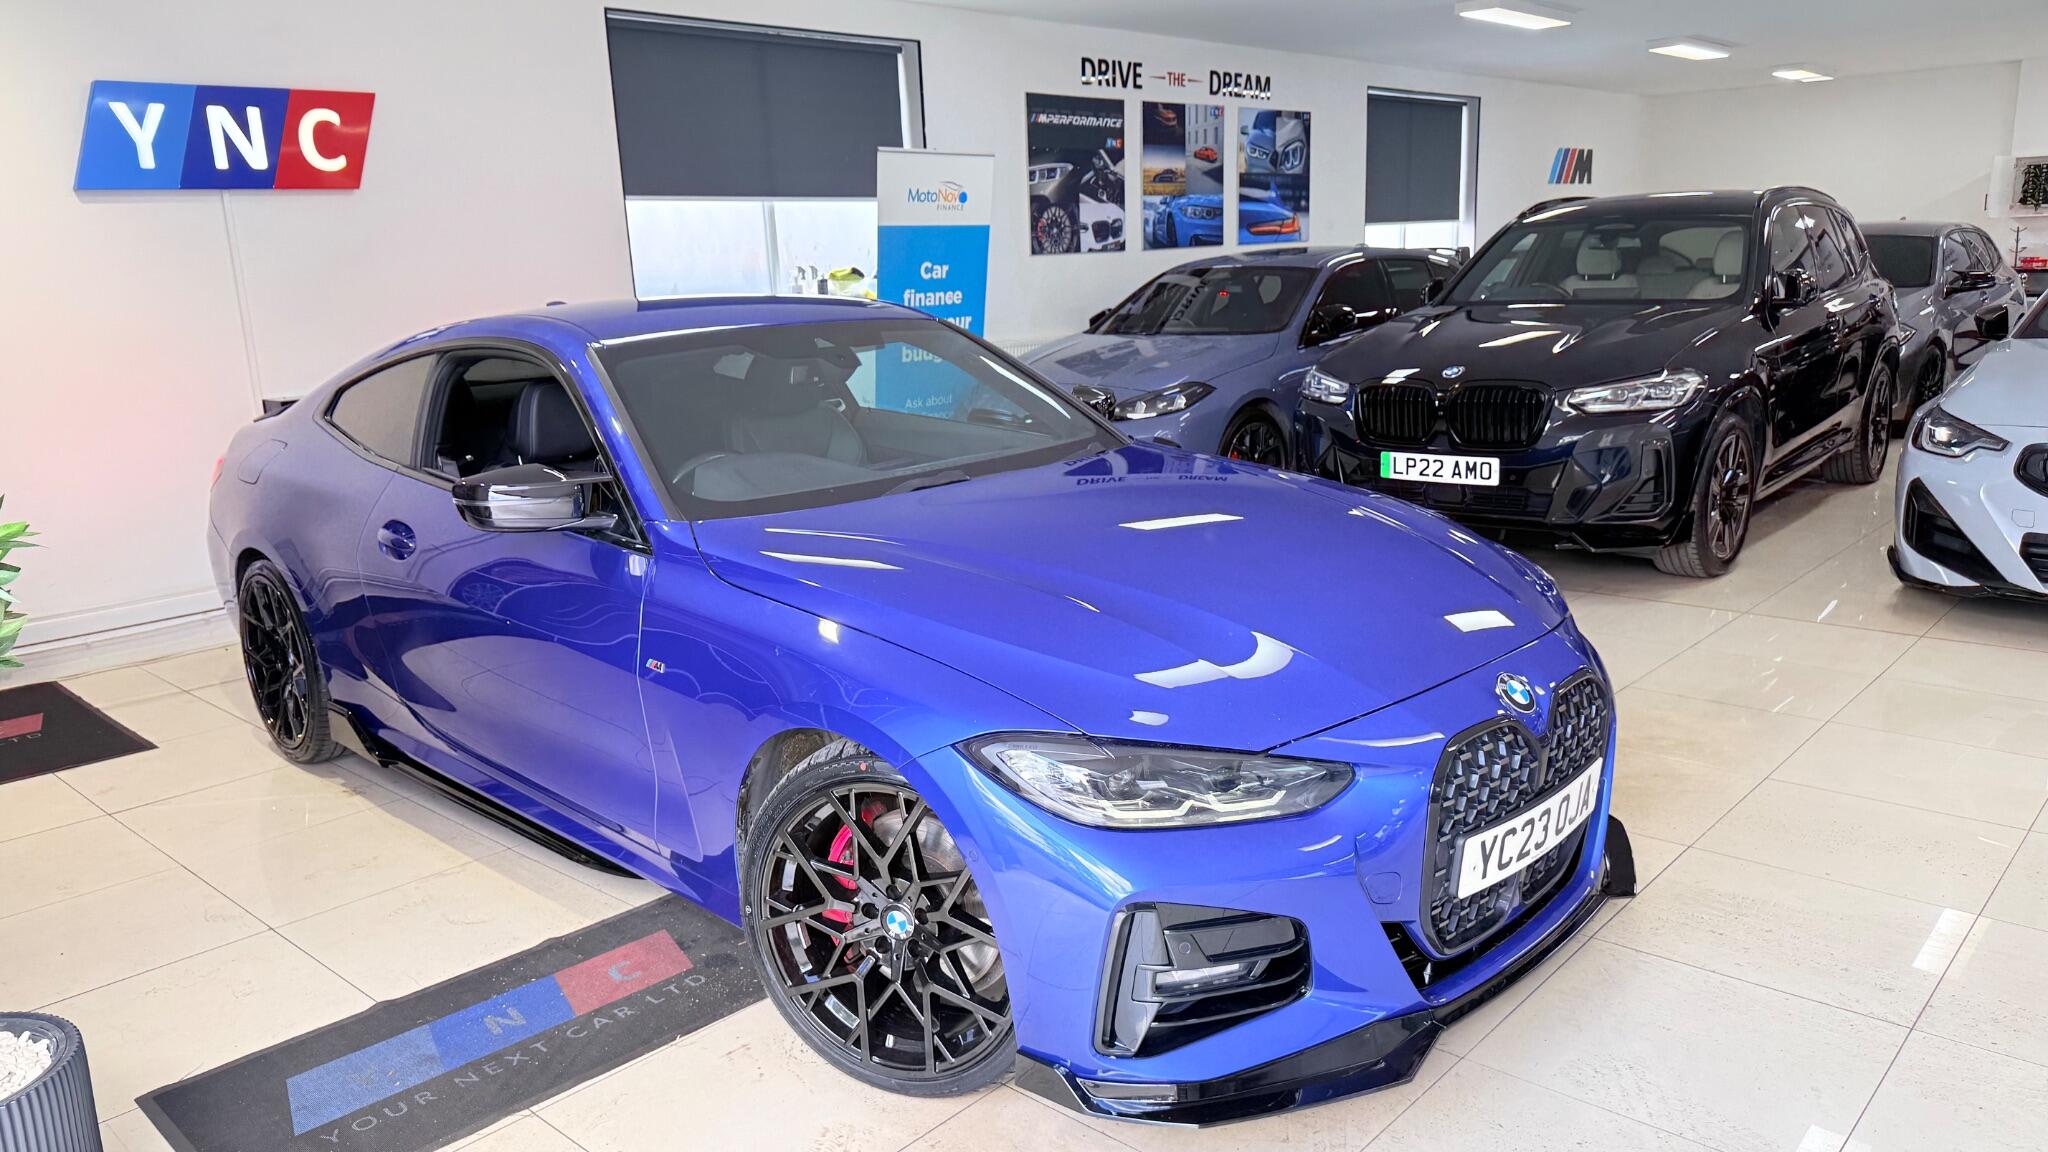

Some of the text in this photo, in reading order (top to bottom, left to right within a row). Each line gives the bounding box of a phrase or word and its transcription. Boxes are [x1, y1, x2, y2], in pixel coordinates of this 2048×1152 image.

[1081, 57, 1271, 100] DRIVE THE DREAM
[108, 101, 348, 172] YNC
[907, 188, 968, 203] MotoNovo
[920, 261, 949, 280] Car
[903, 288, 963, 308] finance
[905, 397, 924, 409] Ask
[1393, 456, 1492, 481] LP22 AMO
[1480, 774, 1592, 880] YC23 OJA
[319, 974, 707, 1144] YOUR NEXT CAR LTD
